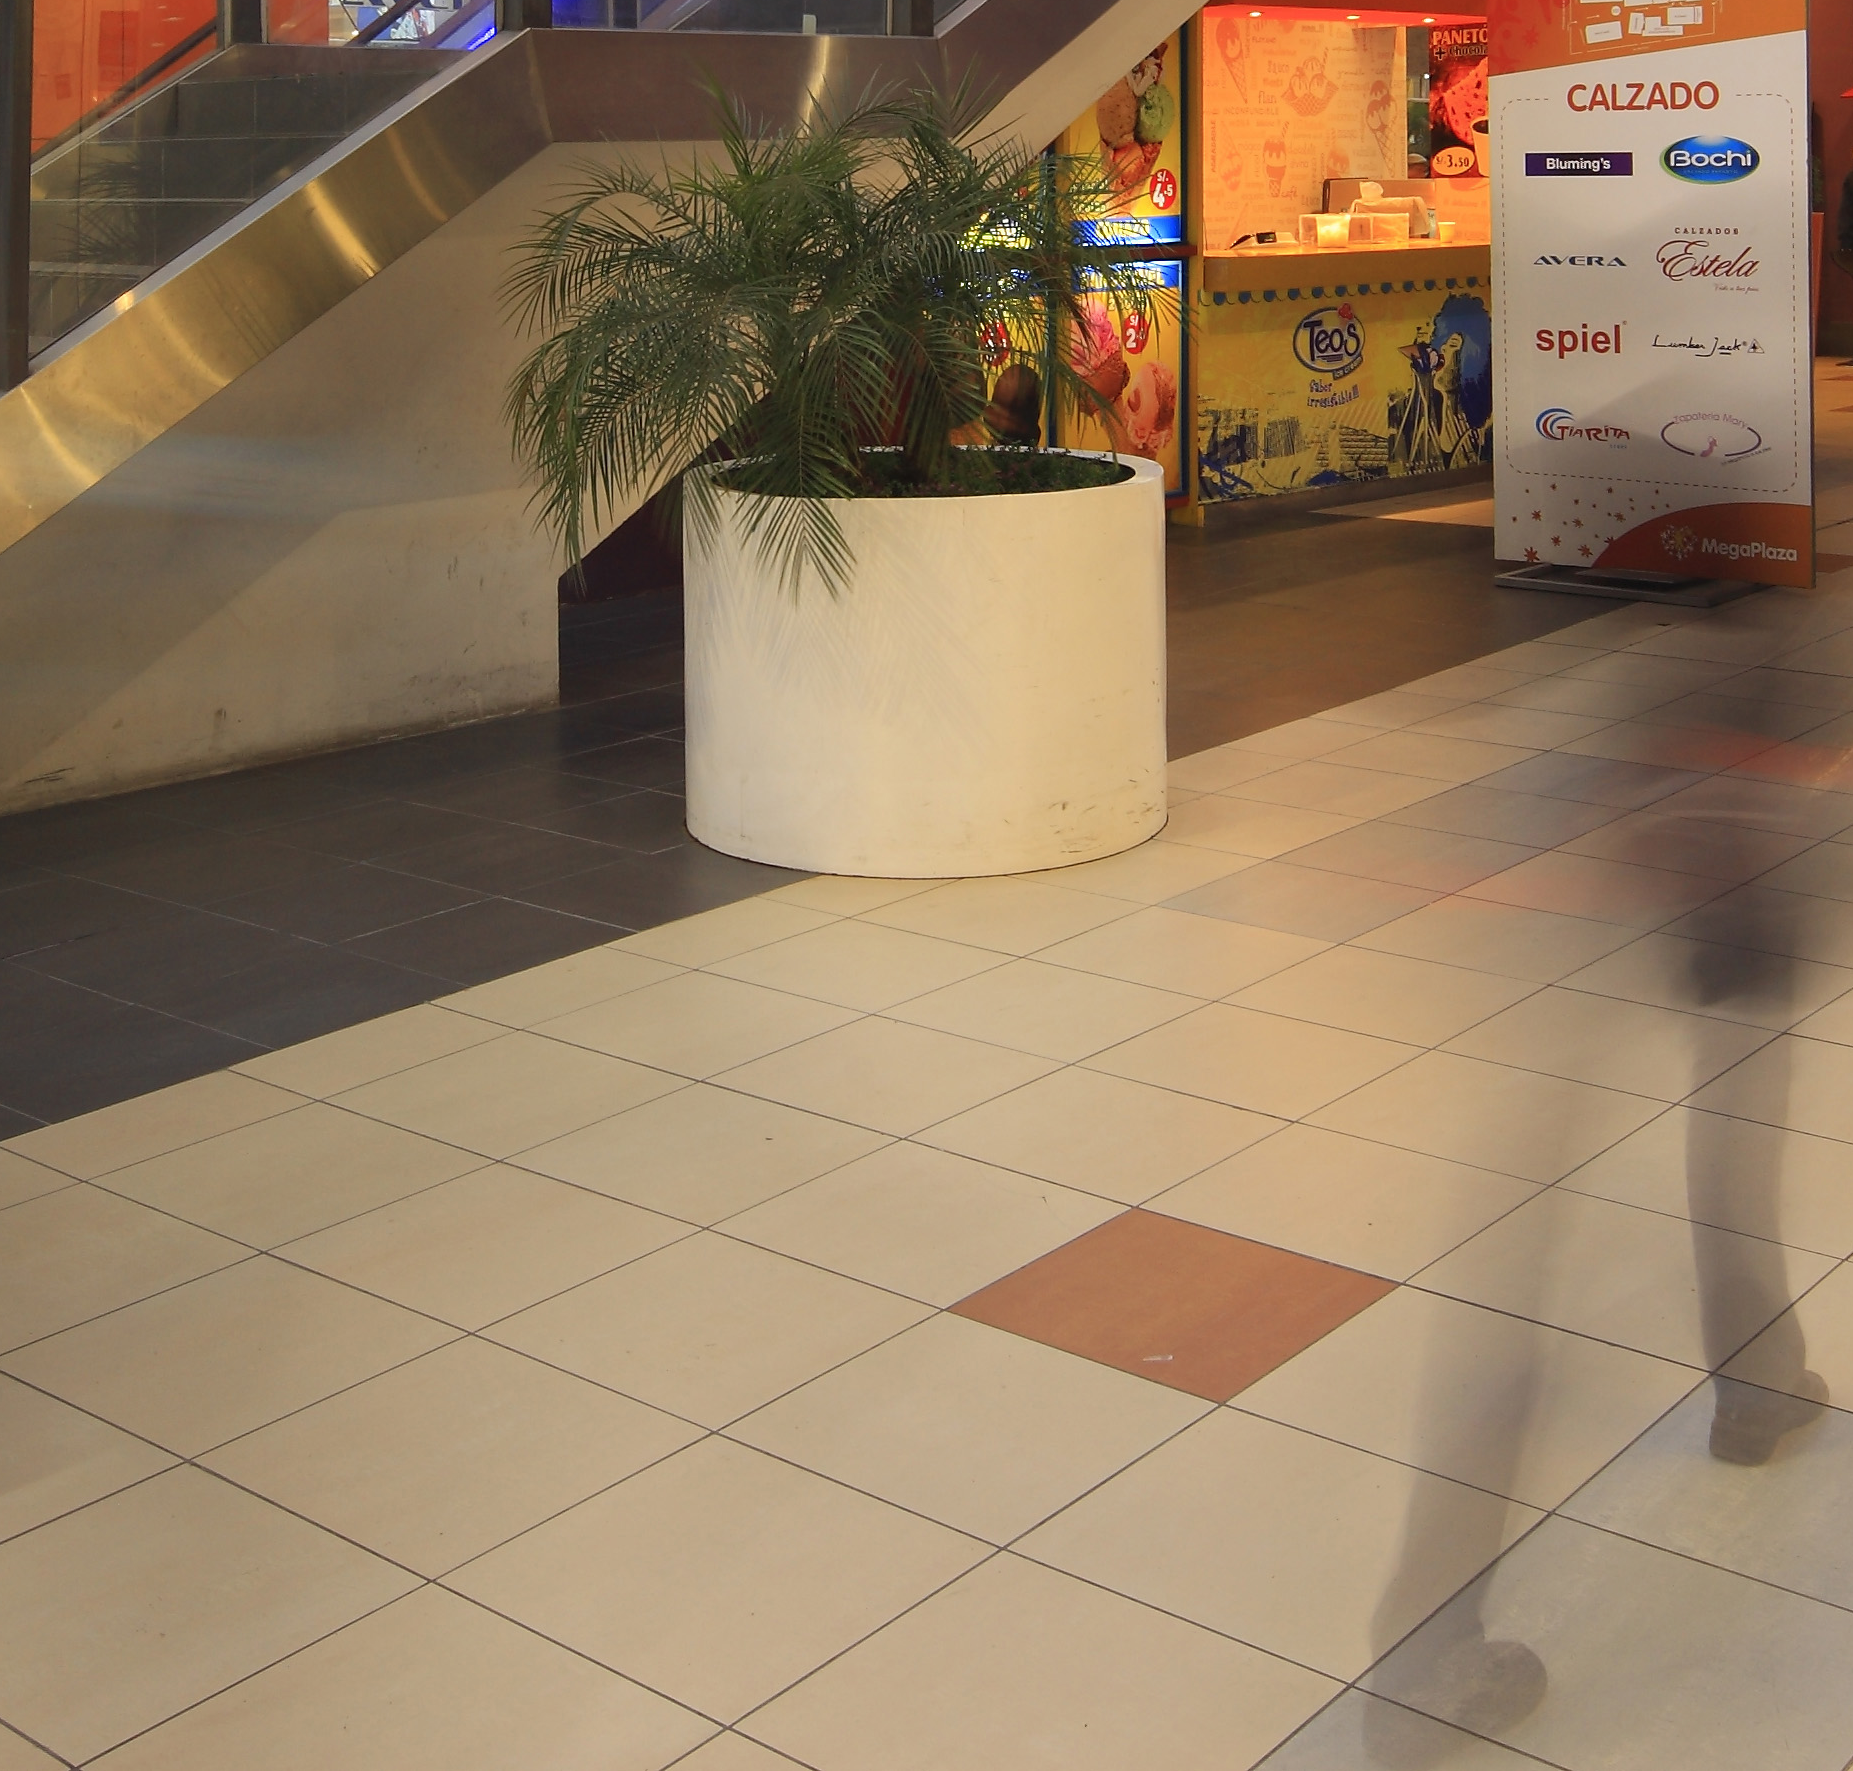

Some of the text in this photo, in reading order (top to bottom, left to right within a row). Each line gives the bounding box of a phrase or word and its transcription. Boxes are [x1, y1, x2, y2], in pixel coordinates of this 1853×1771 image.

[1567, 80, 1720, 112] CALZADO
[1447, 154, 1470, 168] 3.50
[1546, 150, 1752, 172] Bluming's Bochi
[1533, 255, 1627, 267] AVERA
[1655, 240, 1760, 282] Estela
[1303, 320, 1360, 361] Teos
[1536, 323, 1621, 359] spiel
[1701, 537, 1797, 562] MegaPlaza
